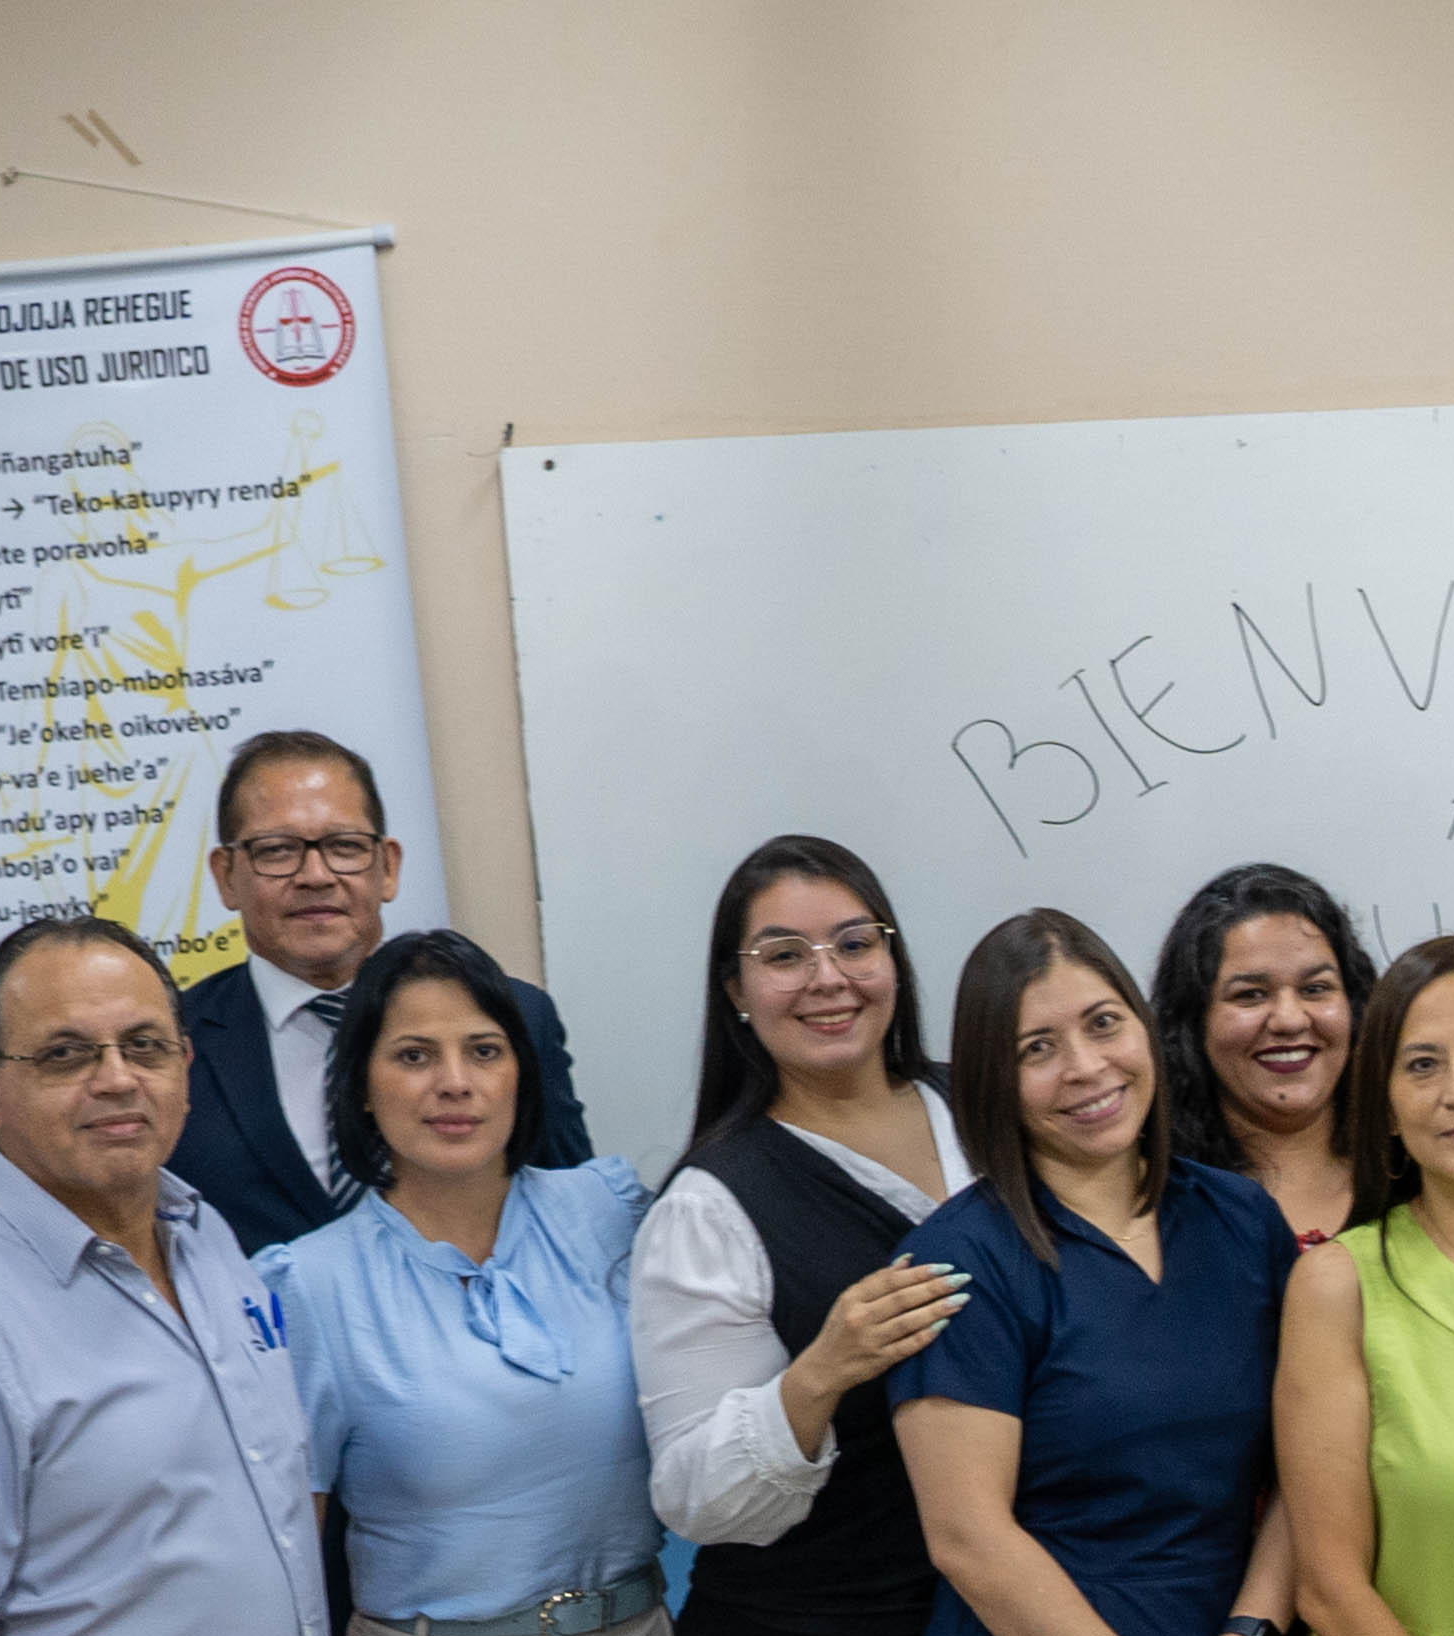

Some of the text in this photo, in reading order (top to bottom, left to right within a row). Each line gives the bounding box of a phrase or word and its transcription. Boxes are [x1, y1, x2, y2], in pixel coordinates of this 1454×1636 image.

[84, 290, 193, 326] REHEGUE
[0, 359, 31, 390] DE
[38, 353, 89, 387] USO
[97, 345, 210, 383] JURIDICO
